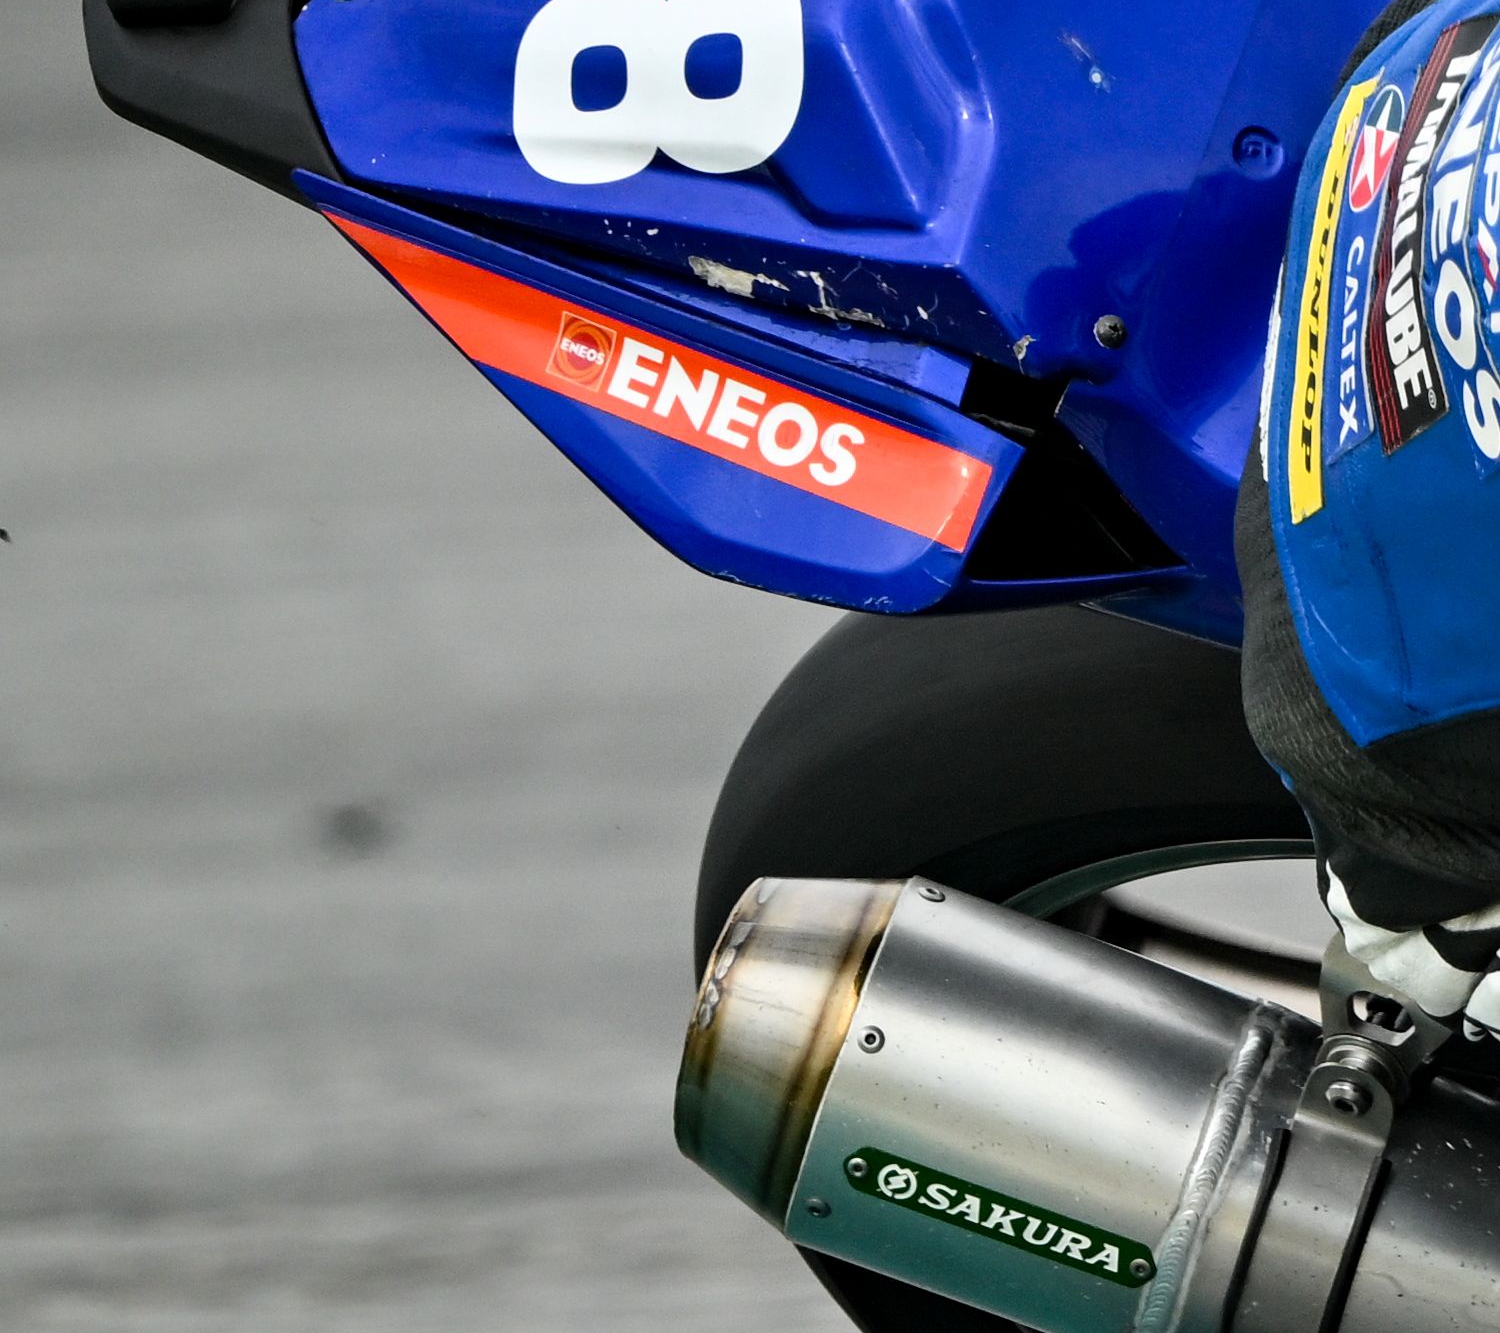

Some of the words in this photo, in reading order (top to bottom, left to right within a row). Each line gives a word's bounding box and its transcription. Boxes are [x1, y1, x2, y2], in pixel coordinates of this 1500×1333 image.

[559, 339, 606, 368] ENEOS
[605, 337, 866, 487] ENEOS
[1299, 176, 1342, 474] DUNLOP
[1338, 236, 1369, 438] CALTEX
[917, 1183, 1120, 1275] SAKURA
